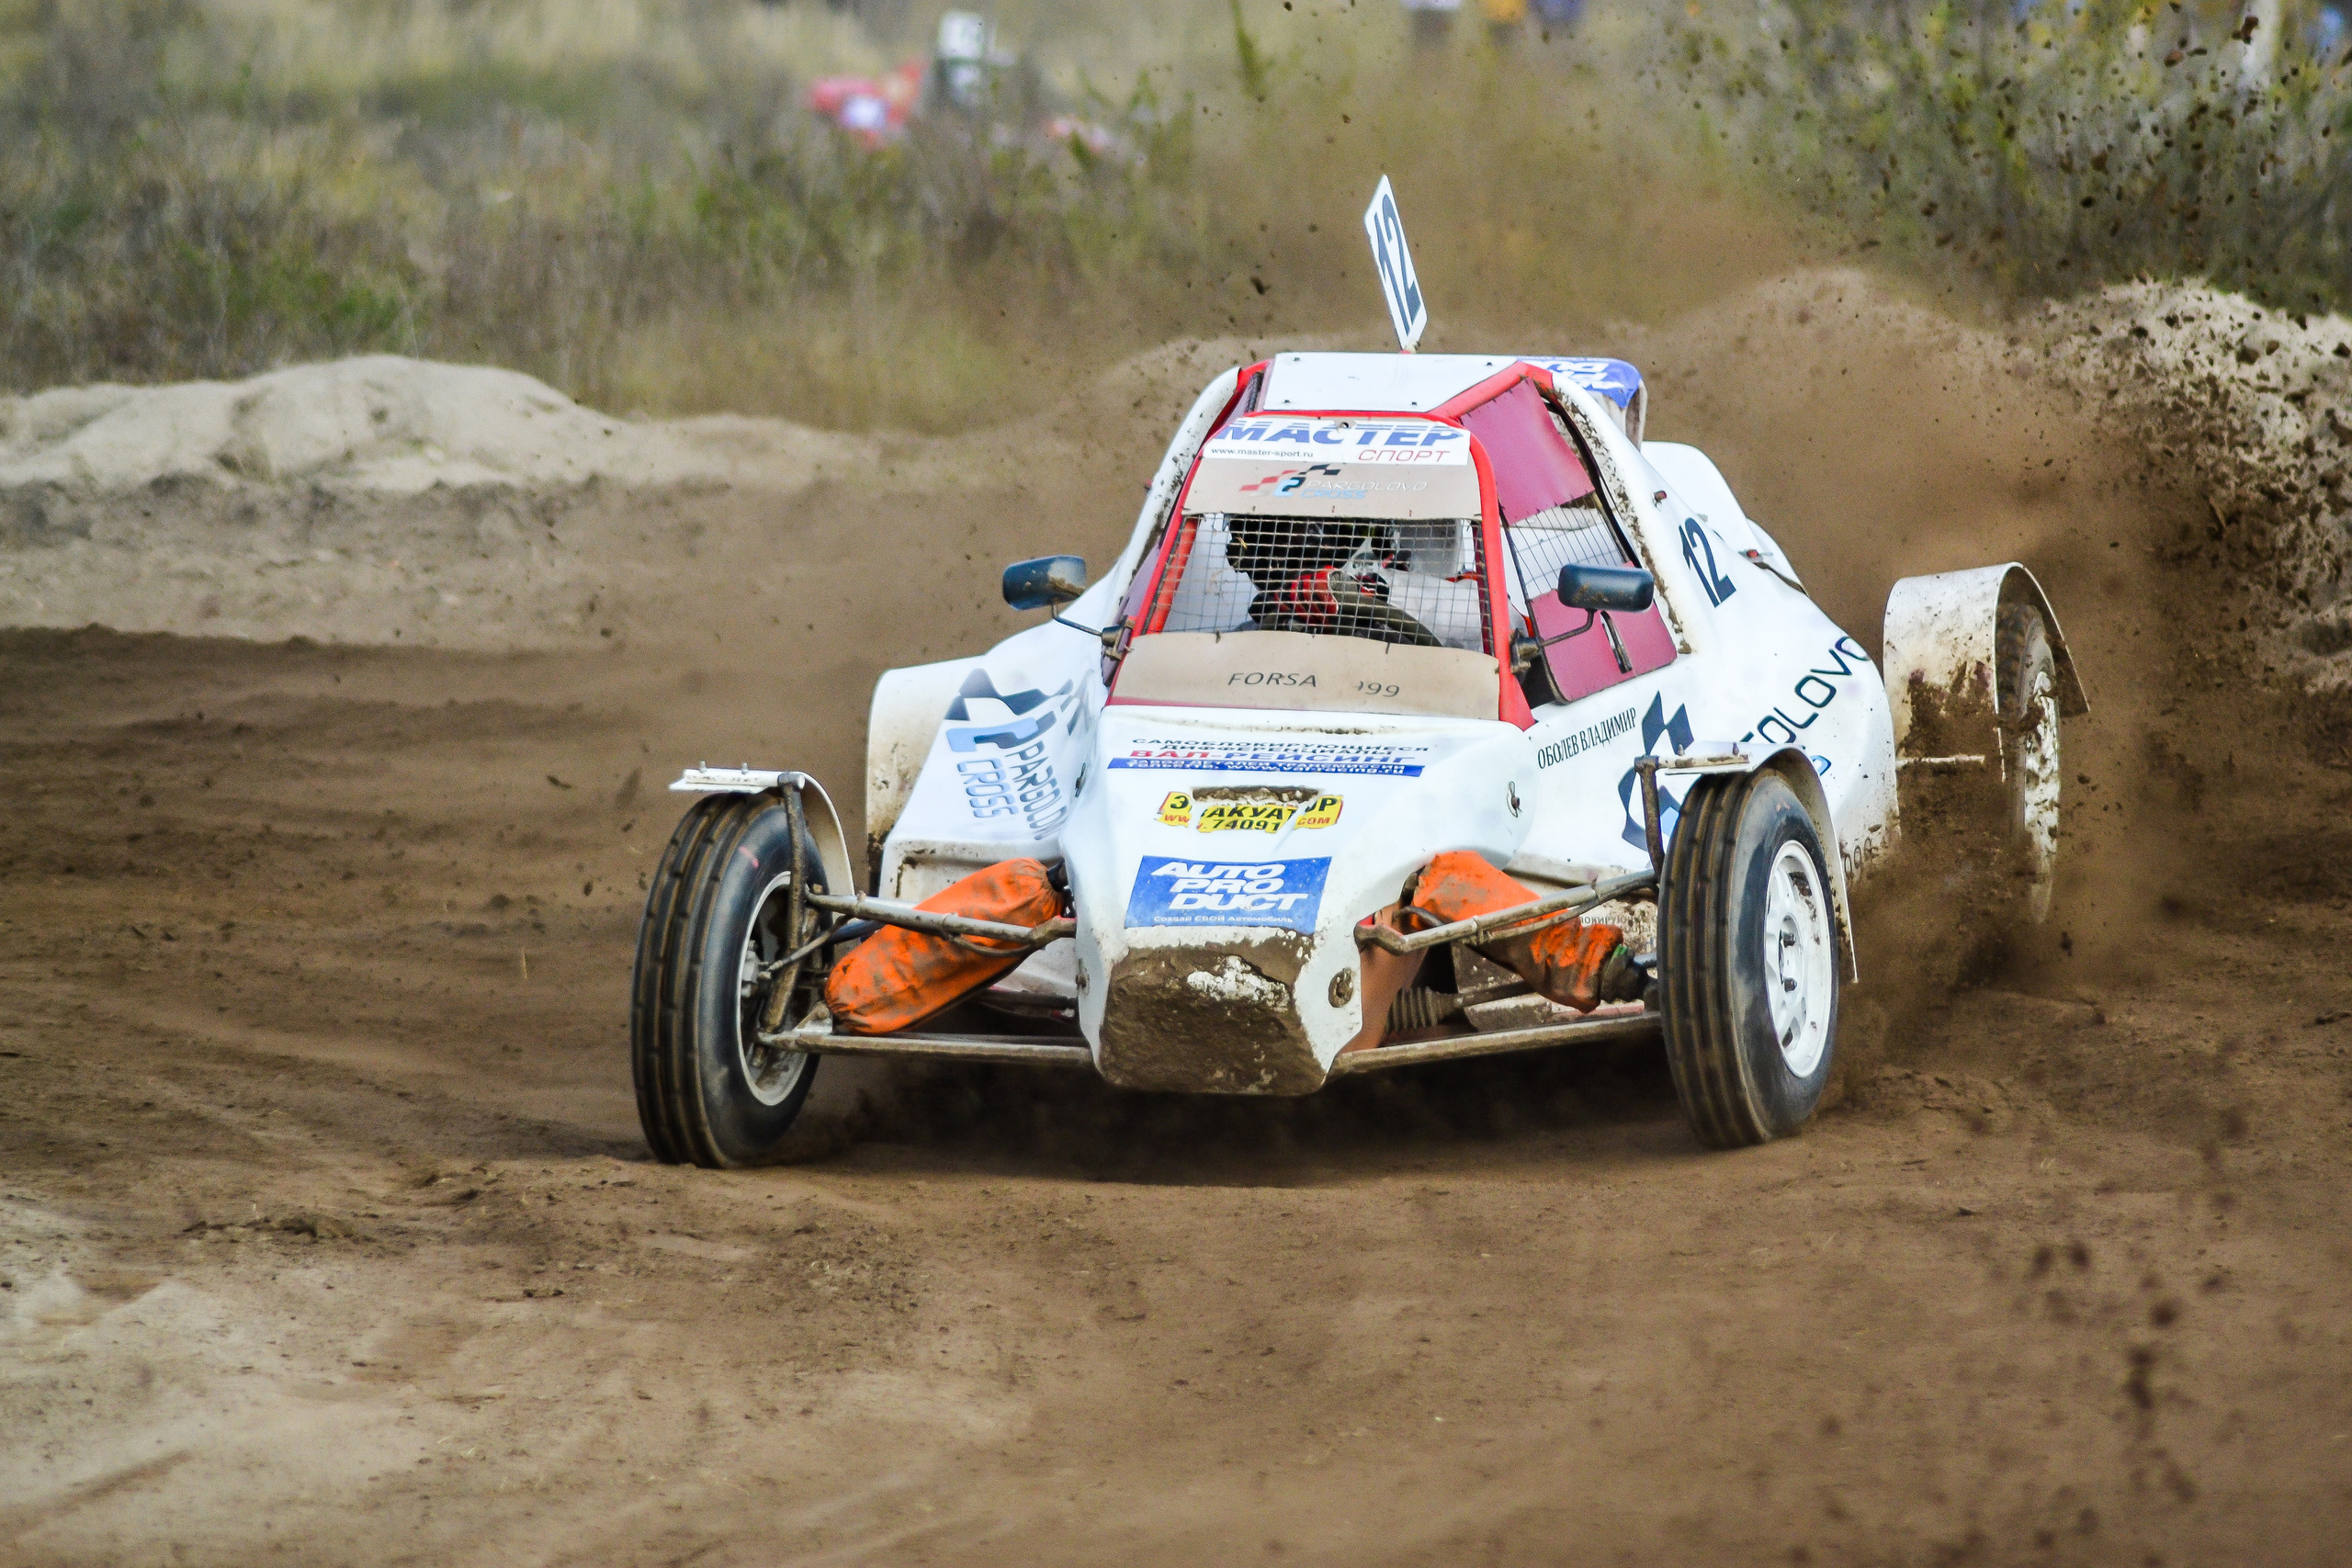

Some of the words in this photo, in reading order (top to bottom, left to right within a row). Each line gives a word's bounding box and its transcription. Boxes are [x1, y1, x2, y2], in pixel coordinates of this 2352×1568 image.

[1374, 193, 1421, 337] 12
[1214, 418, 1464, 446] МАСТЕР
[1211, 447, 1314, 458] www.master-sport.ru
[1358, 449, 1451, 462] СПОРТ
[1306, 480, 1429, 491] PARGOLOVO
[1301, 489, 1368, 500] CROSS
[1678, 516, 1737, 608] 12
[1227, 671, 1317, 688] FORSA
[1132, 738, 1430, 751] САМОБЛОКИРУЮЩИЕСЯ
[1537, 734, 1579, 770] ОБОЛЕВ
[1579, 706, 1636, 752] ВЛАДИМИР
[956, 757, 1019, 818] CROSS
[1150, 861, 1286, 878] AUTO
[1169, 877, 1285, 894] PRO
[1168, 893, 1309, 911] DUCT
[1194, 914, 1226, 922] СВОЙ
[1227, 915, 1294, 923] Автомобиль
